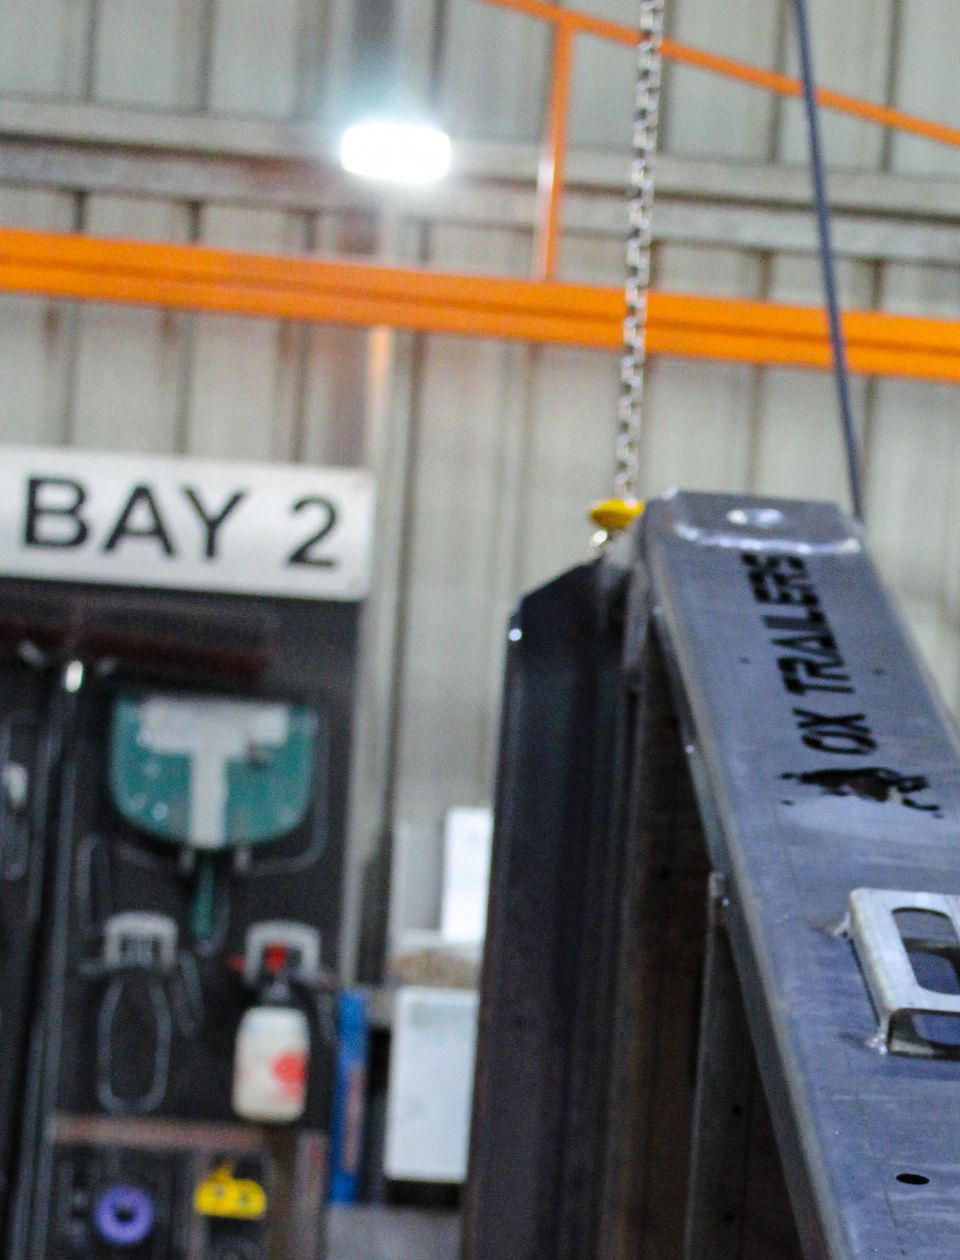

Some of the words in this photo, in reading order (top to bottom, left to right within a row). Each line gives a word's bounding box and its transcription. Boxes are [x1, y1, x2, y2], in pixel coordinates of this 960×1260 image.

[24, 475, 247, 561] BAY
[286, 496, 339, 568] 2
[740, 552, 855, 696] TRAILERS
[791, 706, 878, 756] OX
